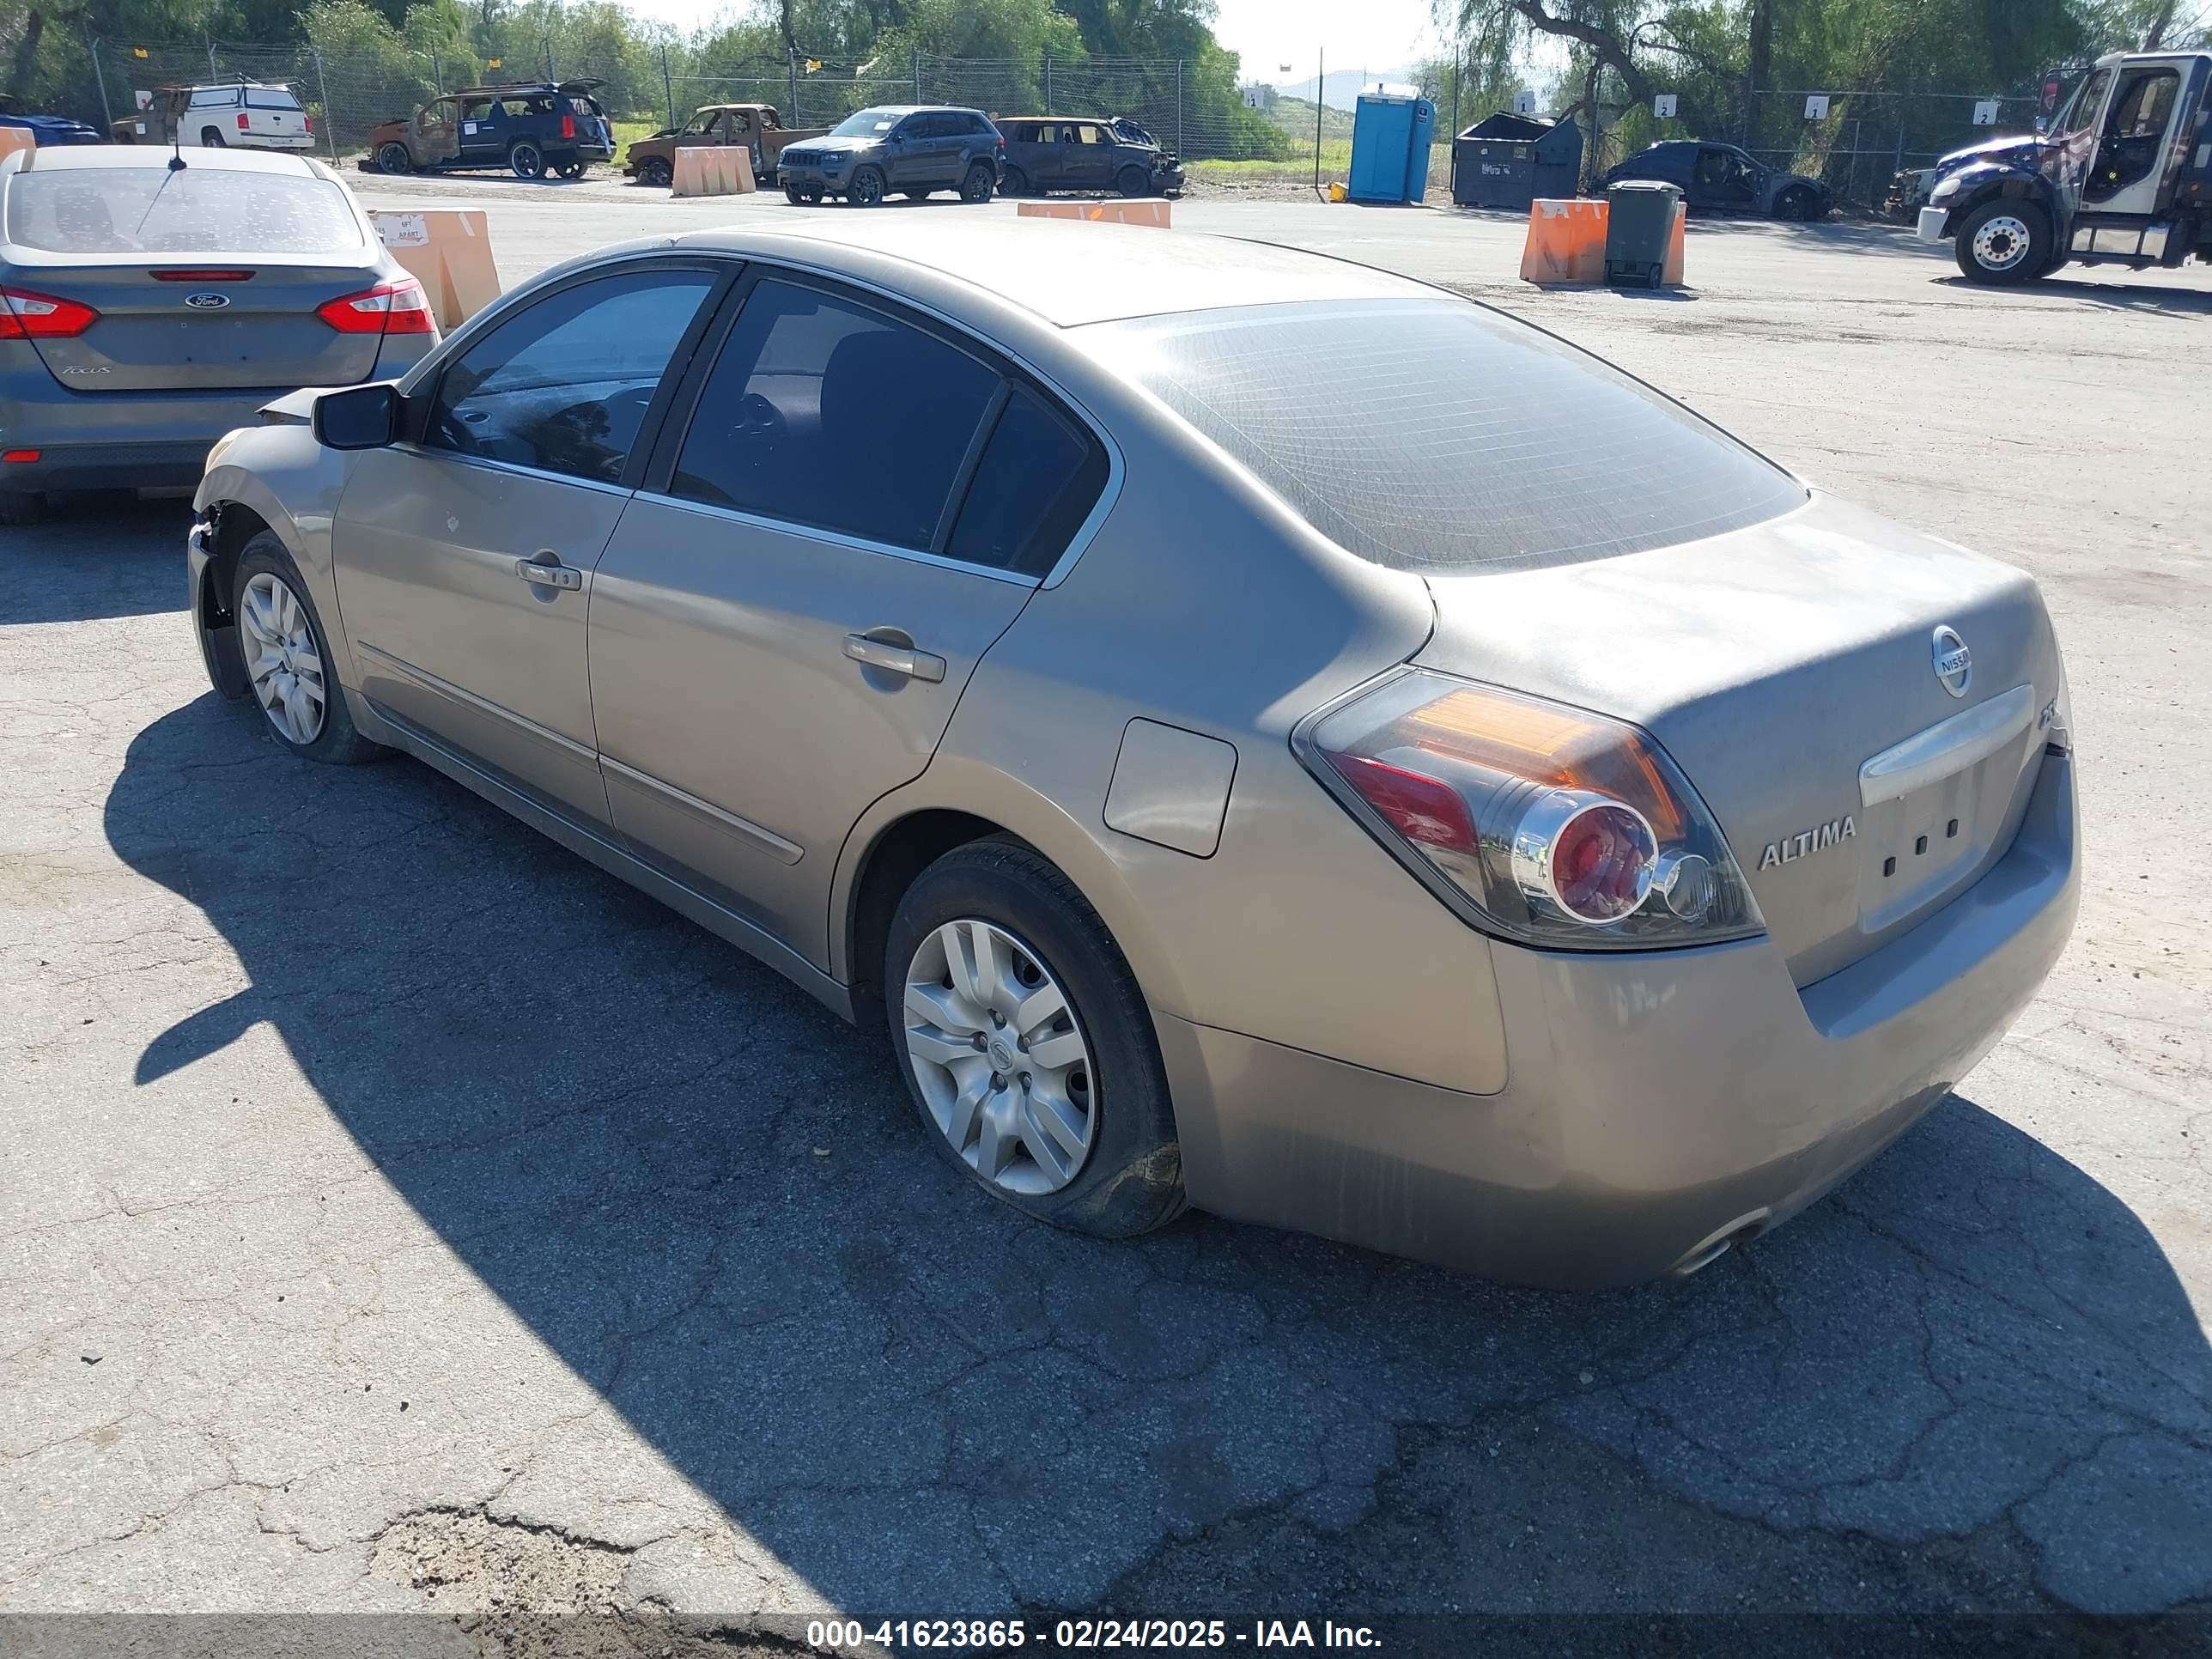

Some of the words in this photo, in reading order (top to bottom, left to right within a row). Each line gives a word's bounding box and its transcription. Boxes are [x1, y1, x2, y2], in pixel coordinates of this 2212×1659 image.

[1661, 106, 1668, 116] 2
[1813, 108, 1818, 118] 1
[1980, 114, 1988, 124] 2
[196, 295, 220, 305] Ford
[1757, 815, 1856, 872] ALTIMA
